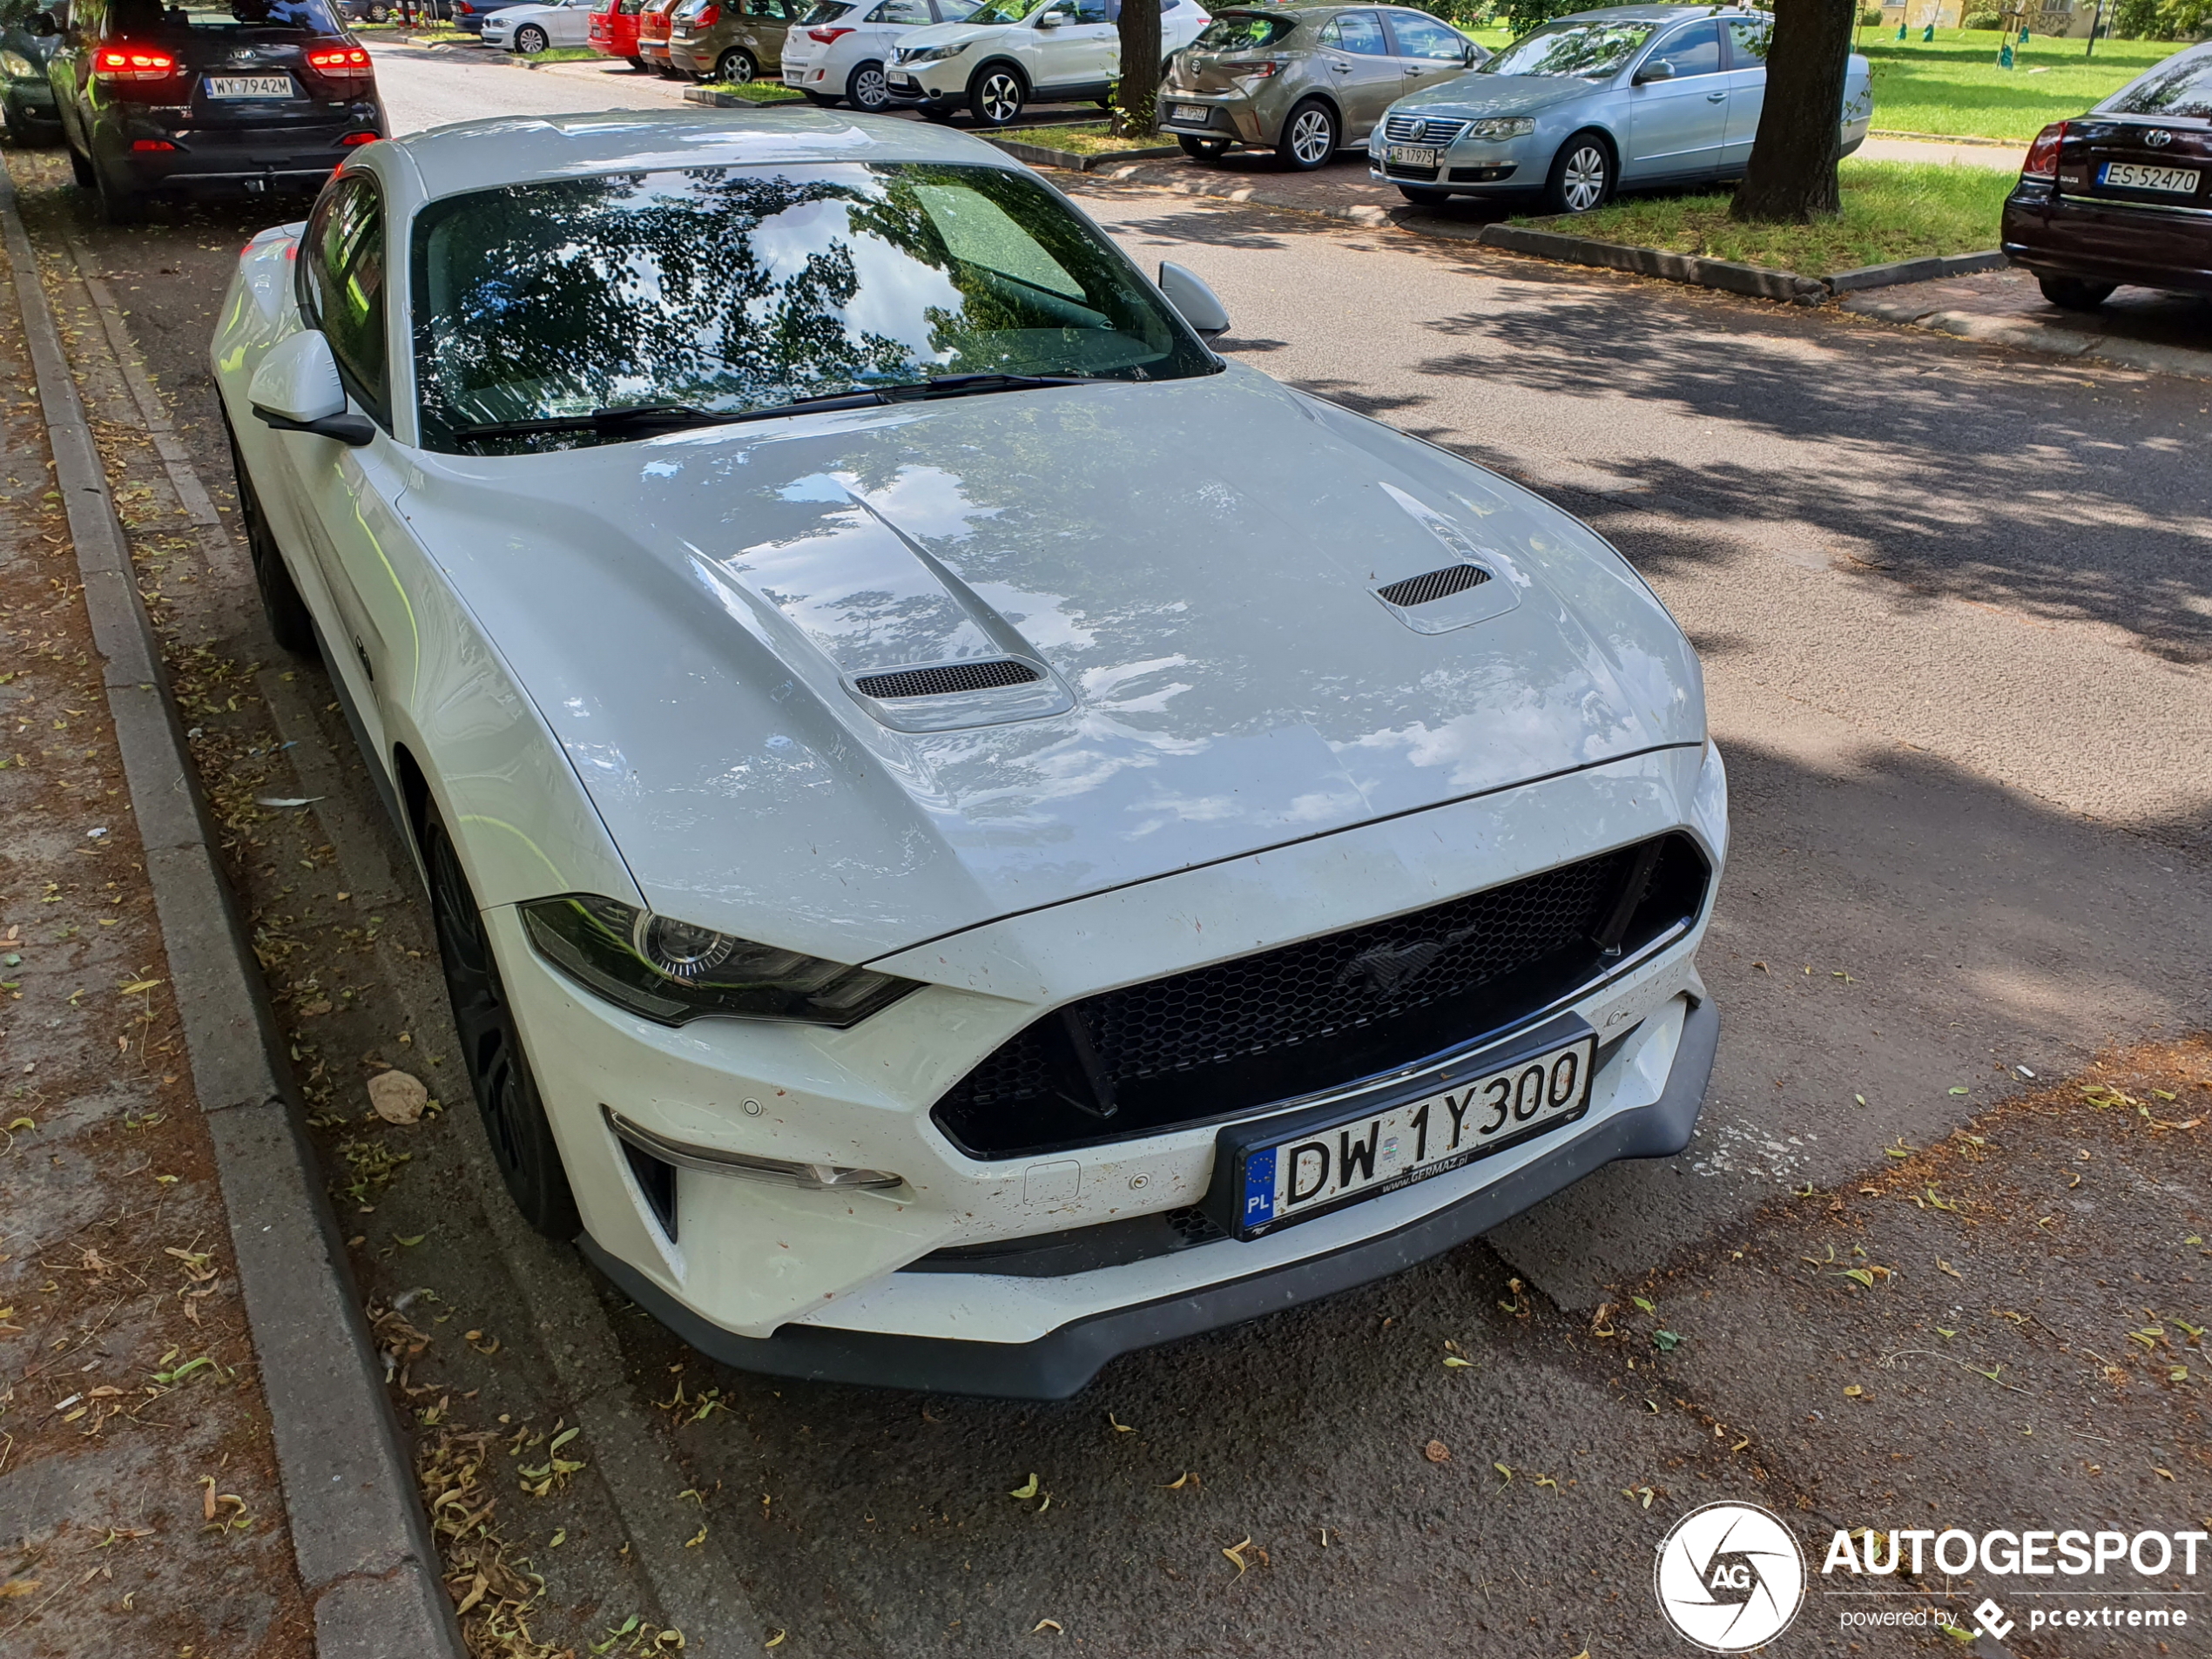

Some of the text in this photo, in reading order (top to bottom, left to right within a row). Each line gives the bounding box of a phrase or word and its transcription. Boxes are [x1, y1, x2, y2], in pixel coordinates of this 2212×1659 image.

[214, 78, 289, 94] WY 7942M
[1406, 149, 1433, 164] 17975
[2107, 165, 2196, 191] ES 52470
[1287, 1051, 1579, 1206] DW 1Y300
[1382, 1154, 1468, 1193] www.GERMAZ.pl
[1247, 1194, 1270, 1214] PL
